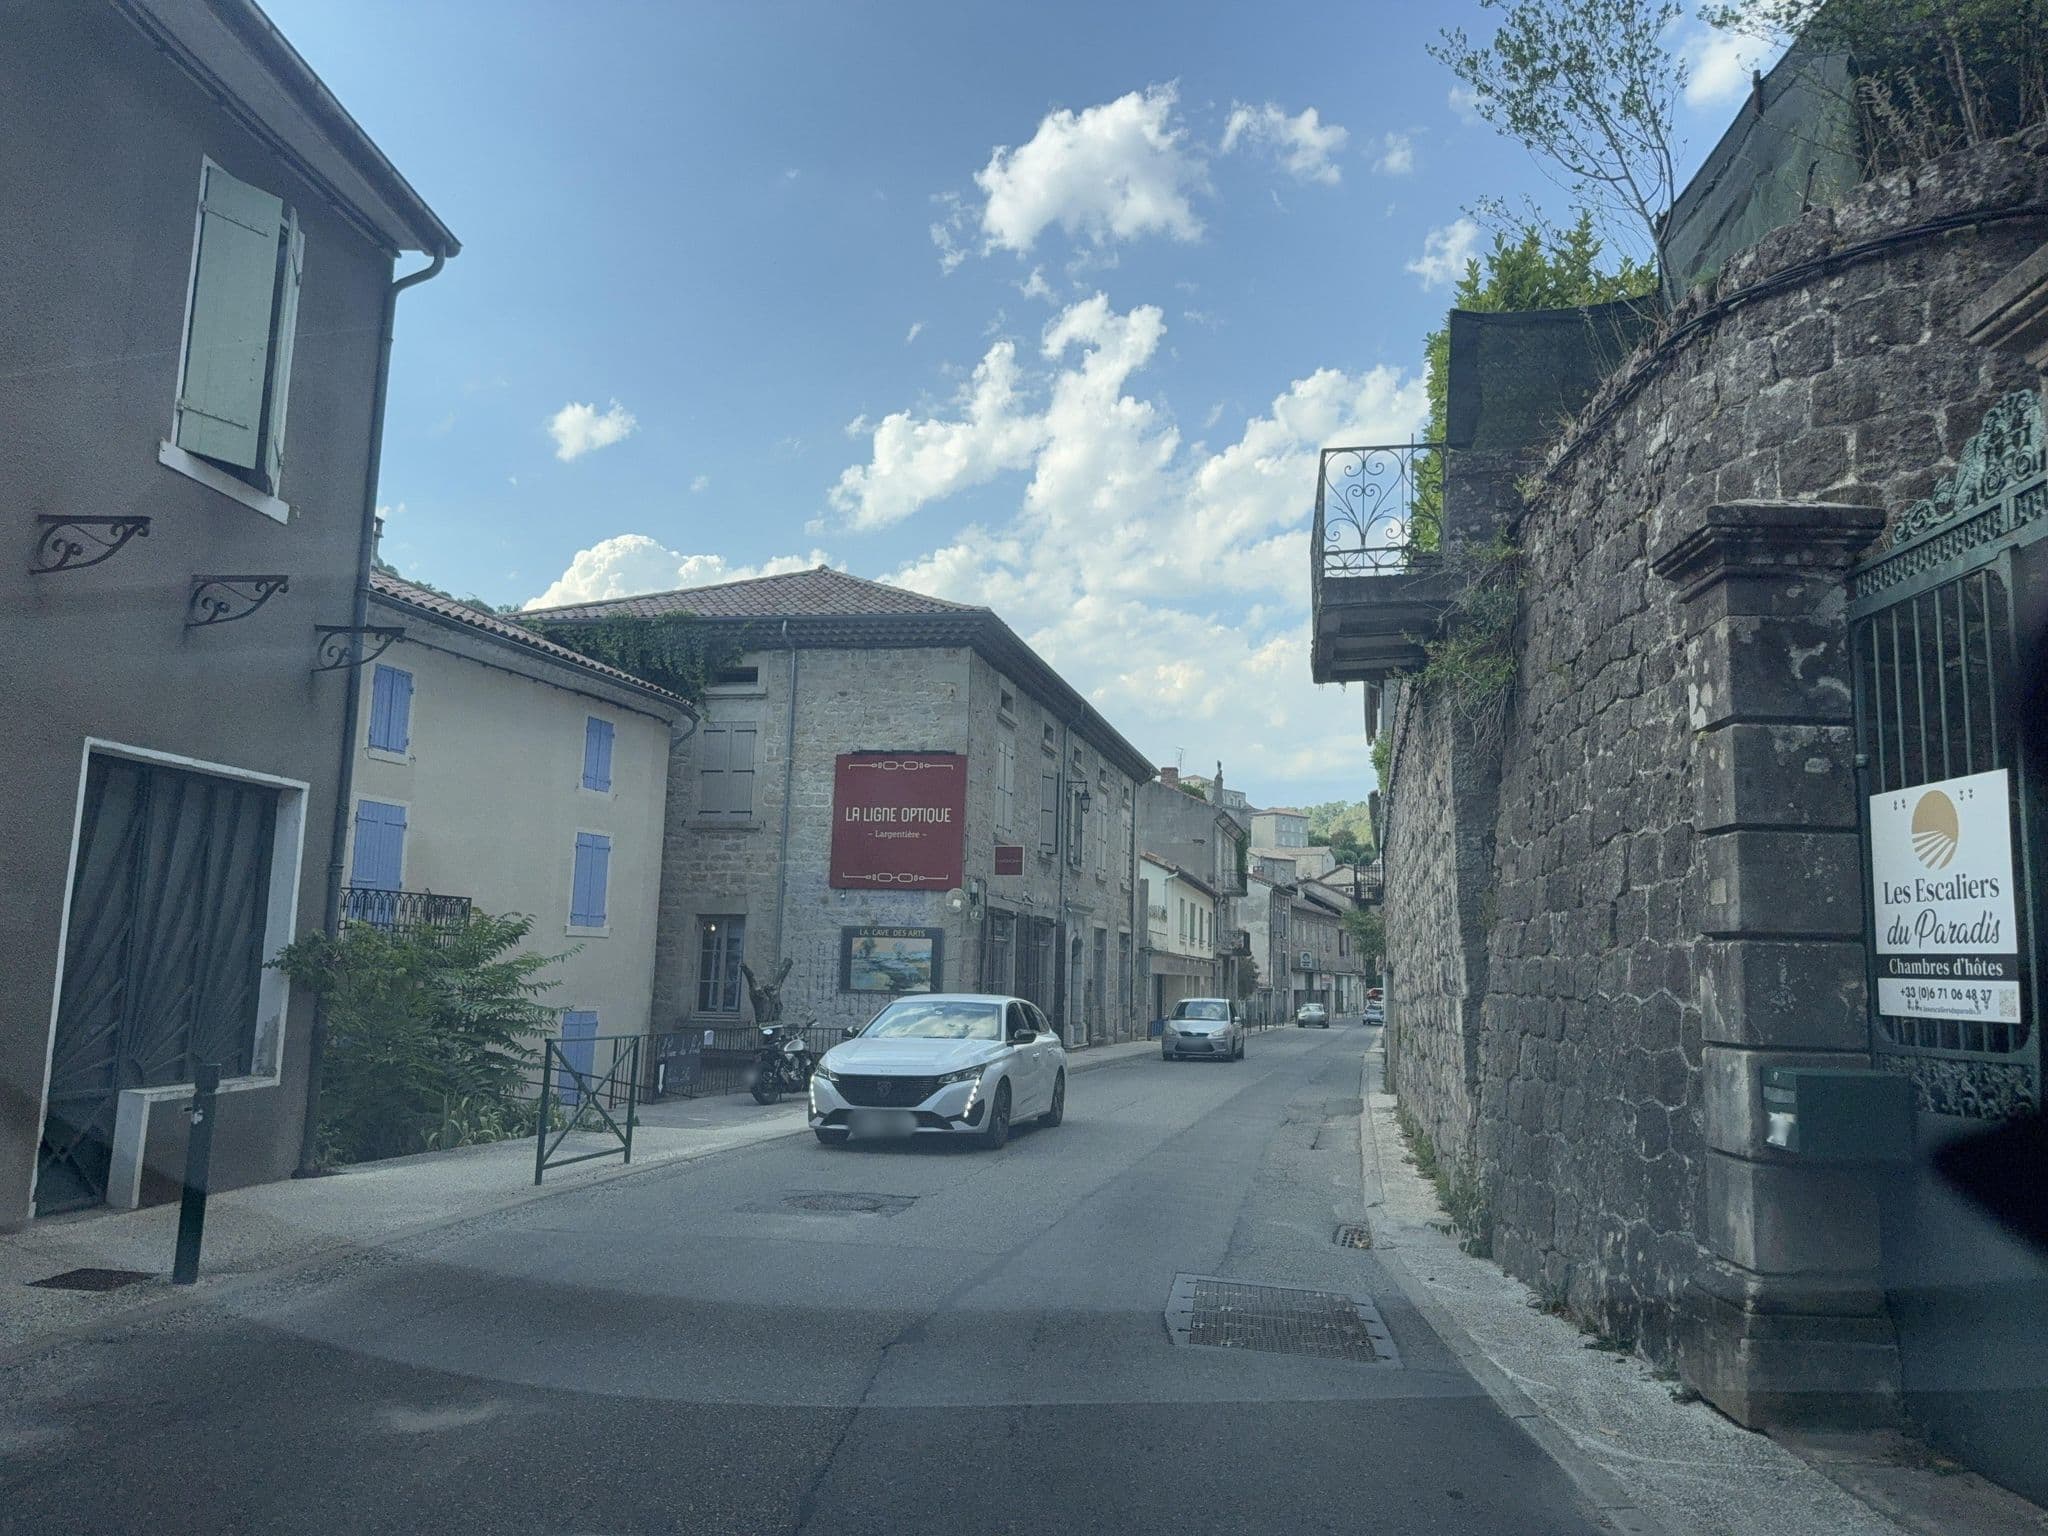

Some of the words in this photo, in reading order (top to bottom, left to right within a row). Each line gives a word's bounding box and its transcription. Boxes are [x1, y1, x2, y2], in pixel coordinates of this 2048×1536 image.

[845, 807, 860, 822] LA
[863, 807, 897, 822] LIGNE
[901, 807, 952, 823] OPTIQUE
[875, 829, 920, 839] Largentière
[1883, 881, 1912, 905] Les
[1915, 873, 2000, 903] Escaliers
[859, 928, 869, 936] LA
[872, 928, 889, 936] CAVE
[893, 929, 907, 937] DES
[908, 929, 926, 937] ARTS
[1887, 914, 1912, 945] du
[1914, 908, 2001, 948] Paradis
[1889, 957, 1950, 976] Chambres
[1953, 957, 2004, 977] d'hôtes
[1900, 985, 1916, 998] +33
[1918, 986, 1935, 1001] (0)6
[1937, 987, 1948, 999] 71
[1951, 988, 1963, 1001] 06
[1965, 988, 1978, 1001] 48
[1980, 989, 1993, 1002] 37
